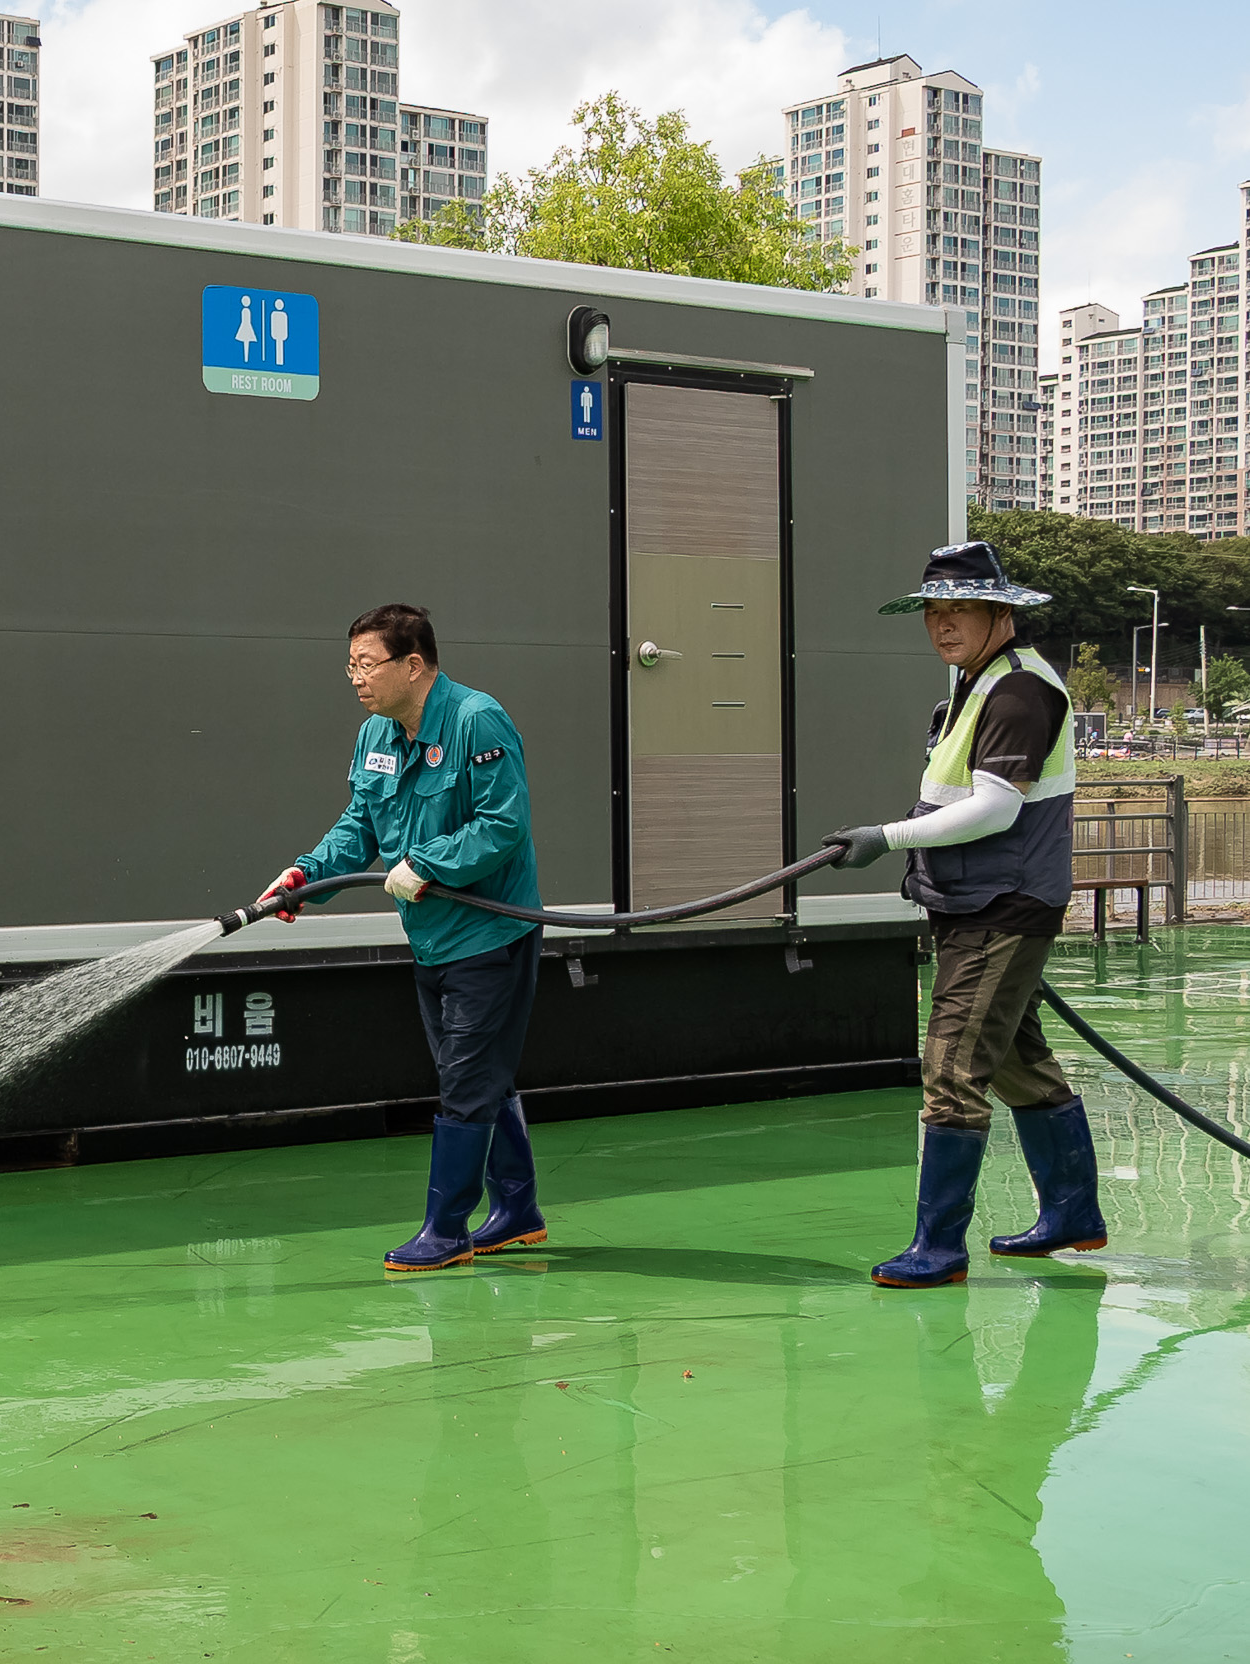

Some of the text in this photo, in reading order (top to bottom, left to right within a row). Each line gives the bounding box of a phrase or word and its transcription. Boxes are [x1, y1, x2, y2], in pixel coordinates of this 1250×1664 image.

[901, 138, 916, 253] 현대홈타운
[231, 374, 292, 393] REST ROOM
[577, 427, 597, 436] MEN
[186, 1043, 281, 1071] 010-6807-9449
